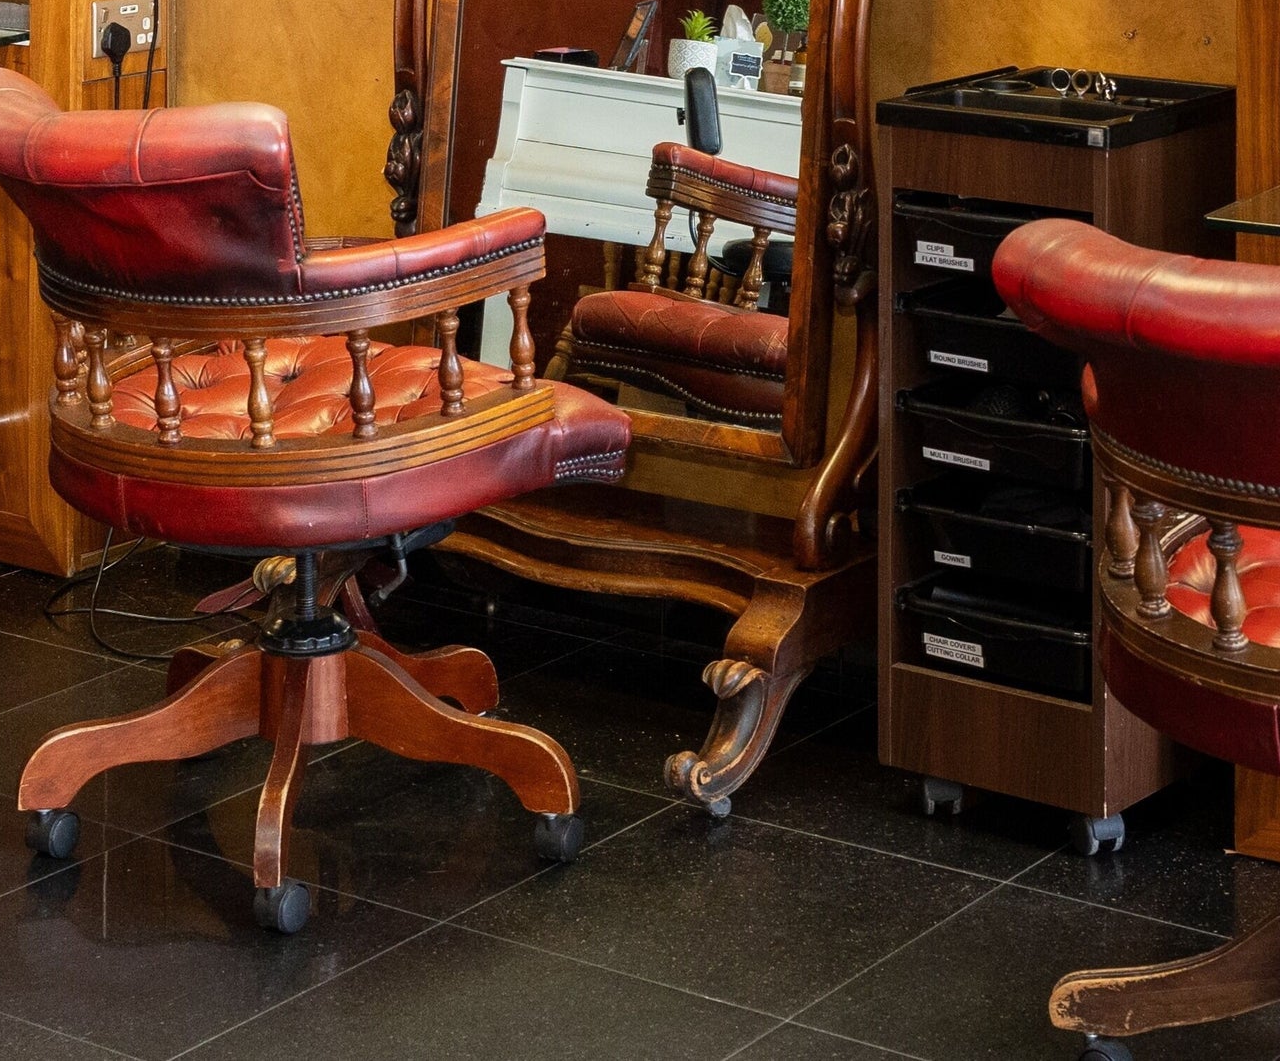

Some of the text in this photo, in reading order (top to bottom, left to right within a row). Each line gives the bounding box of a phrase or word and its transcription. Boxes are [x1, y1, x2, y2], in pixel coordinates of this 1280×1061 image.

[925, 244, 945, 254] CLIPS
[921, 255, 969, 269] FLAT BRUSHES
[933, 353, 987, 370] ROUND BRUSHES
[929, 450, 984, 468] MULTI BRUSHES
[940, 552, 966, 565] GOWNS
[928, 635, 977, 653] CHAIR COVERS
[926, 645, 981, 664] CUTTING COLLAR
